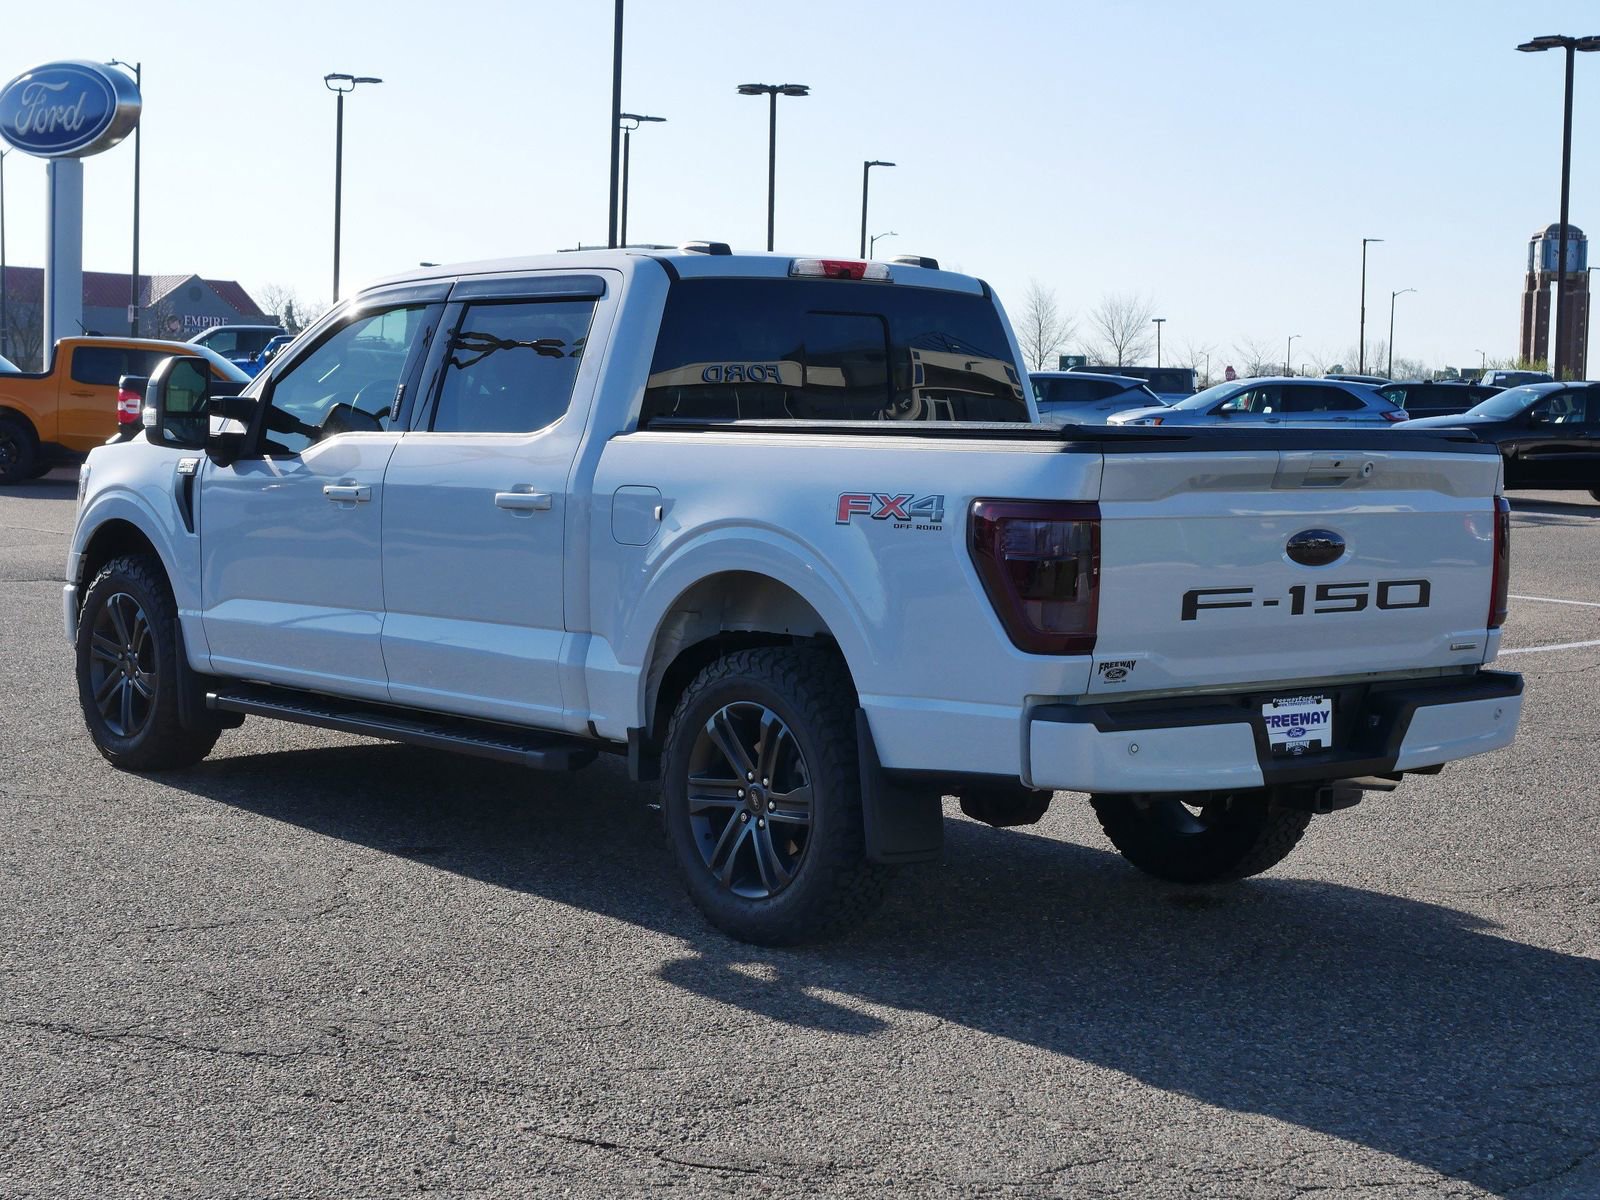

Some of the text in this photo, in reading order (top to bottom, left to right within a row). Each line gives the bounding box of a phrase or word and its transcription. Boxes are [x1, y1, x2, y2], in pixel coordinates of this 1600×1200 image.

[15, 81, 87, 136] Ford
[184, 315, 228, 327] EMPIRE
[835, 491, 945, 525] FX4
[1181, 579, 1431, 621] F-150
[1098, 660, 1136, 675] FREEWAY
